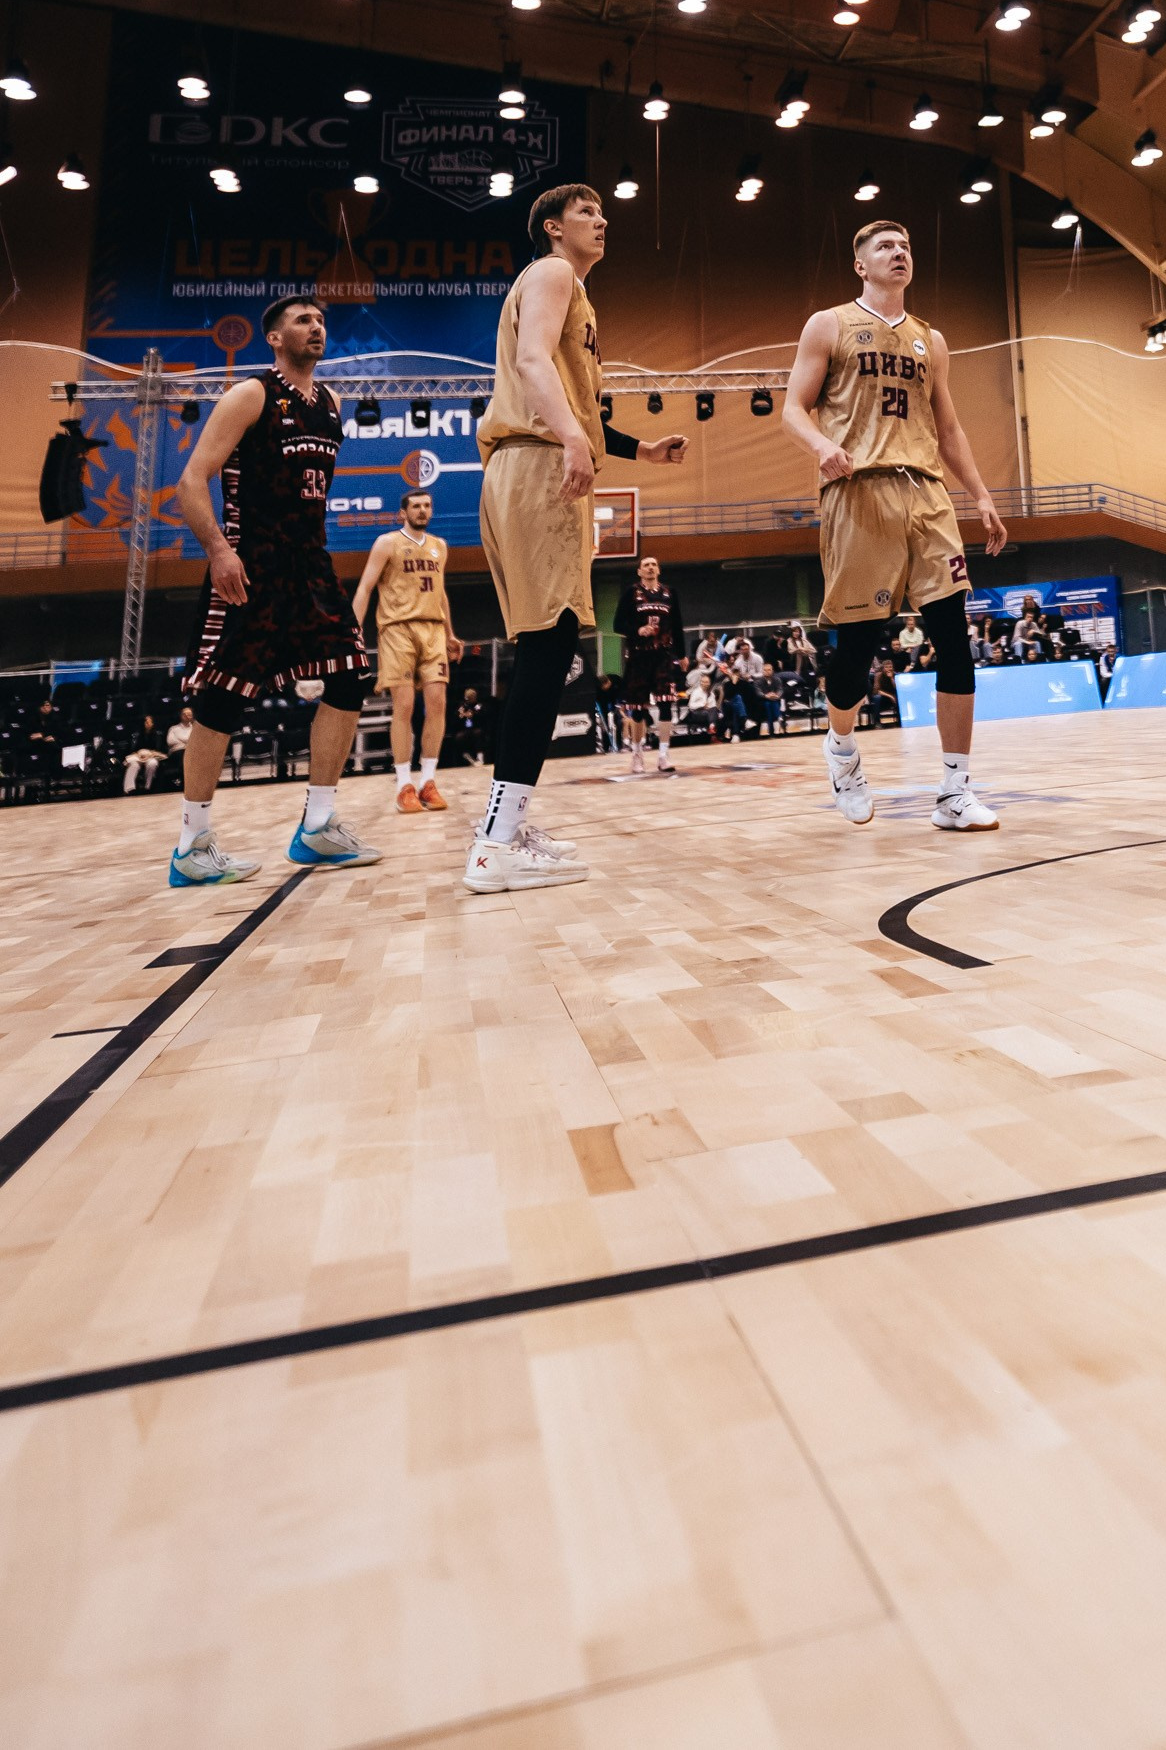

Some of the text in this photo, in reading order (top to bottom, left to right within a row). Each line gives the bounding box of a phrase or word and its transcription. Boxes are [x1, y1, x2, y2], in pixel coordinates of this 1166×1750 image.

[219, 115, 349, 148] DKC
[398, 124, 494, 145] ФИНАЛ
[429, 175, 473, 185] ТВЕРЬ
[174, 239, 515, 278] ЦЕЛЬ ОДНА
[173, 281, 266, 298] ЮБИЛЕЙНЫЙ
[270, 282, 296, 298] ГОД
[300, 282, 424, 298] БАСКЕТБОЛЬНОГО
[428, 282, 471, 297] КЛУБА
[857, 351, 926, 384] ЦИВС
[881, 386, 908, 420] 28
[301, 468, 326, 501] 33
[948, 554, 967, 584] 2
